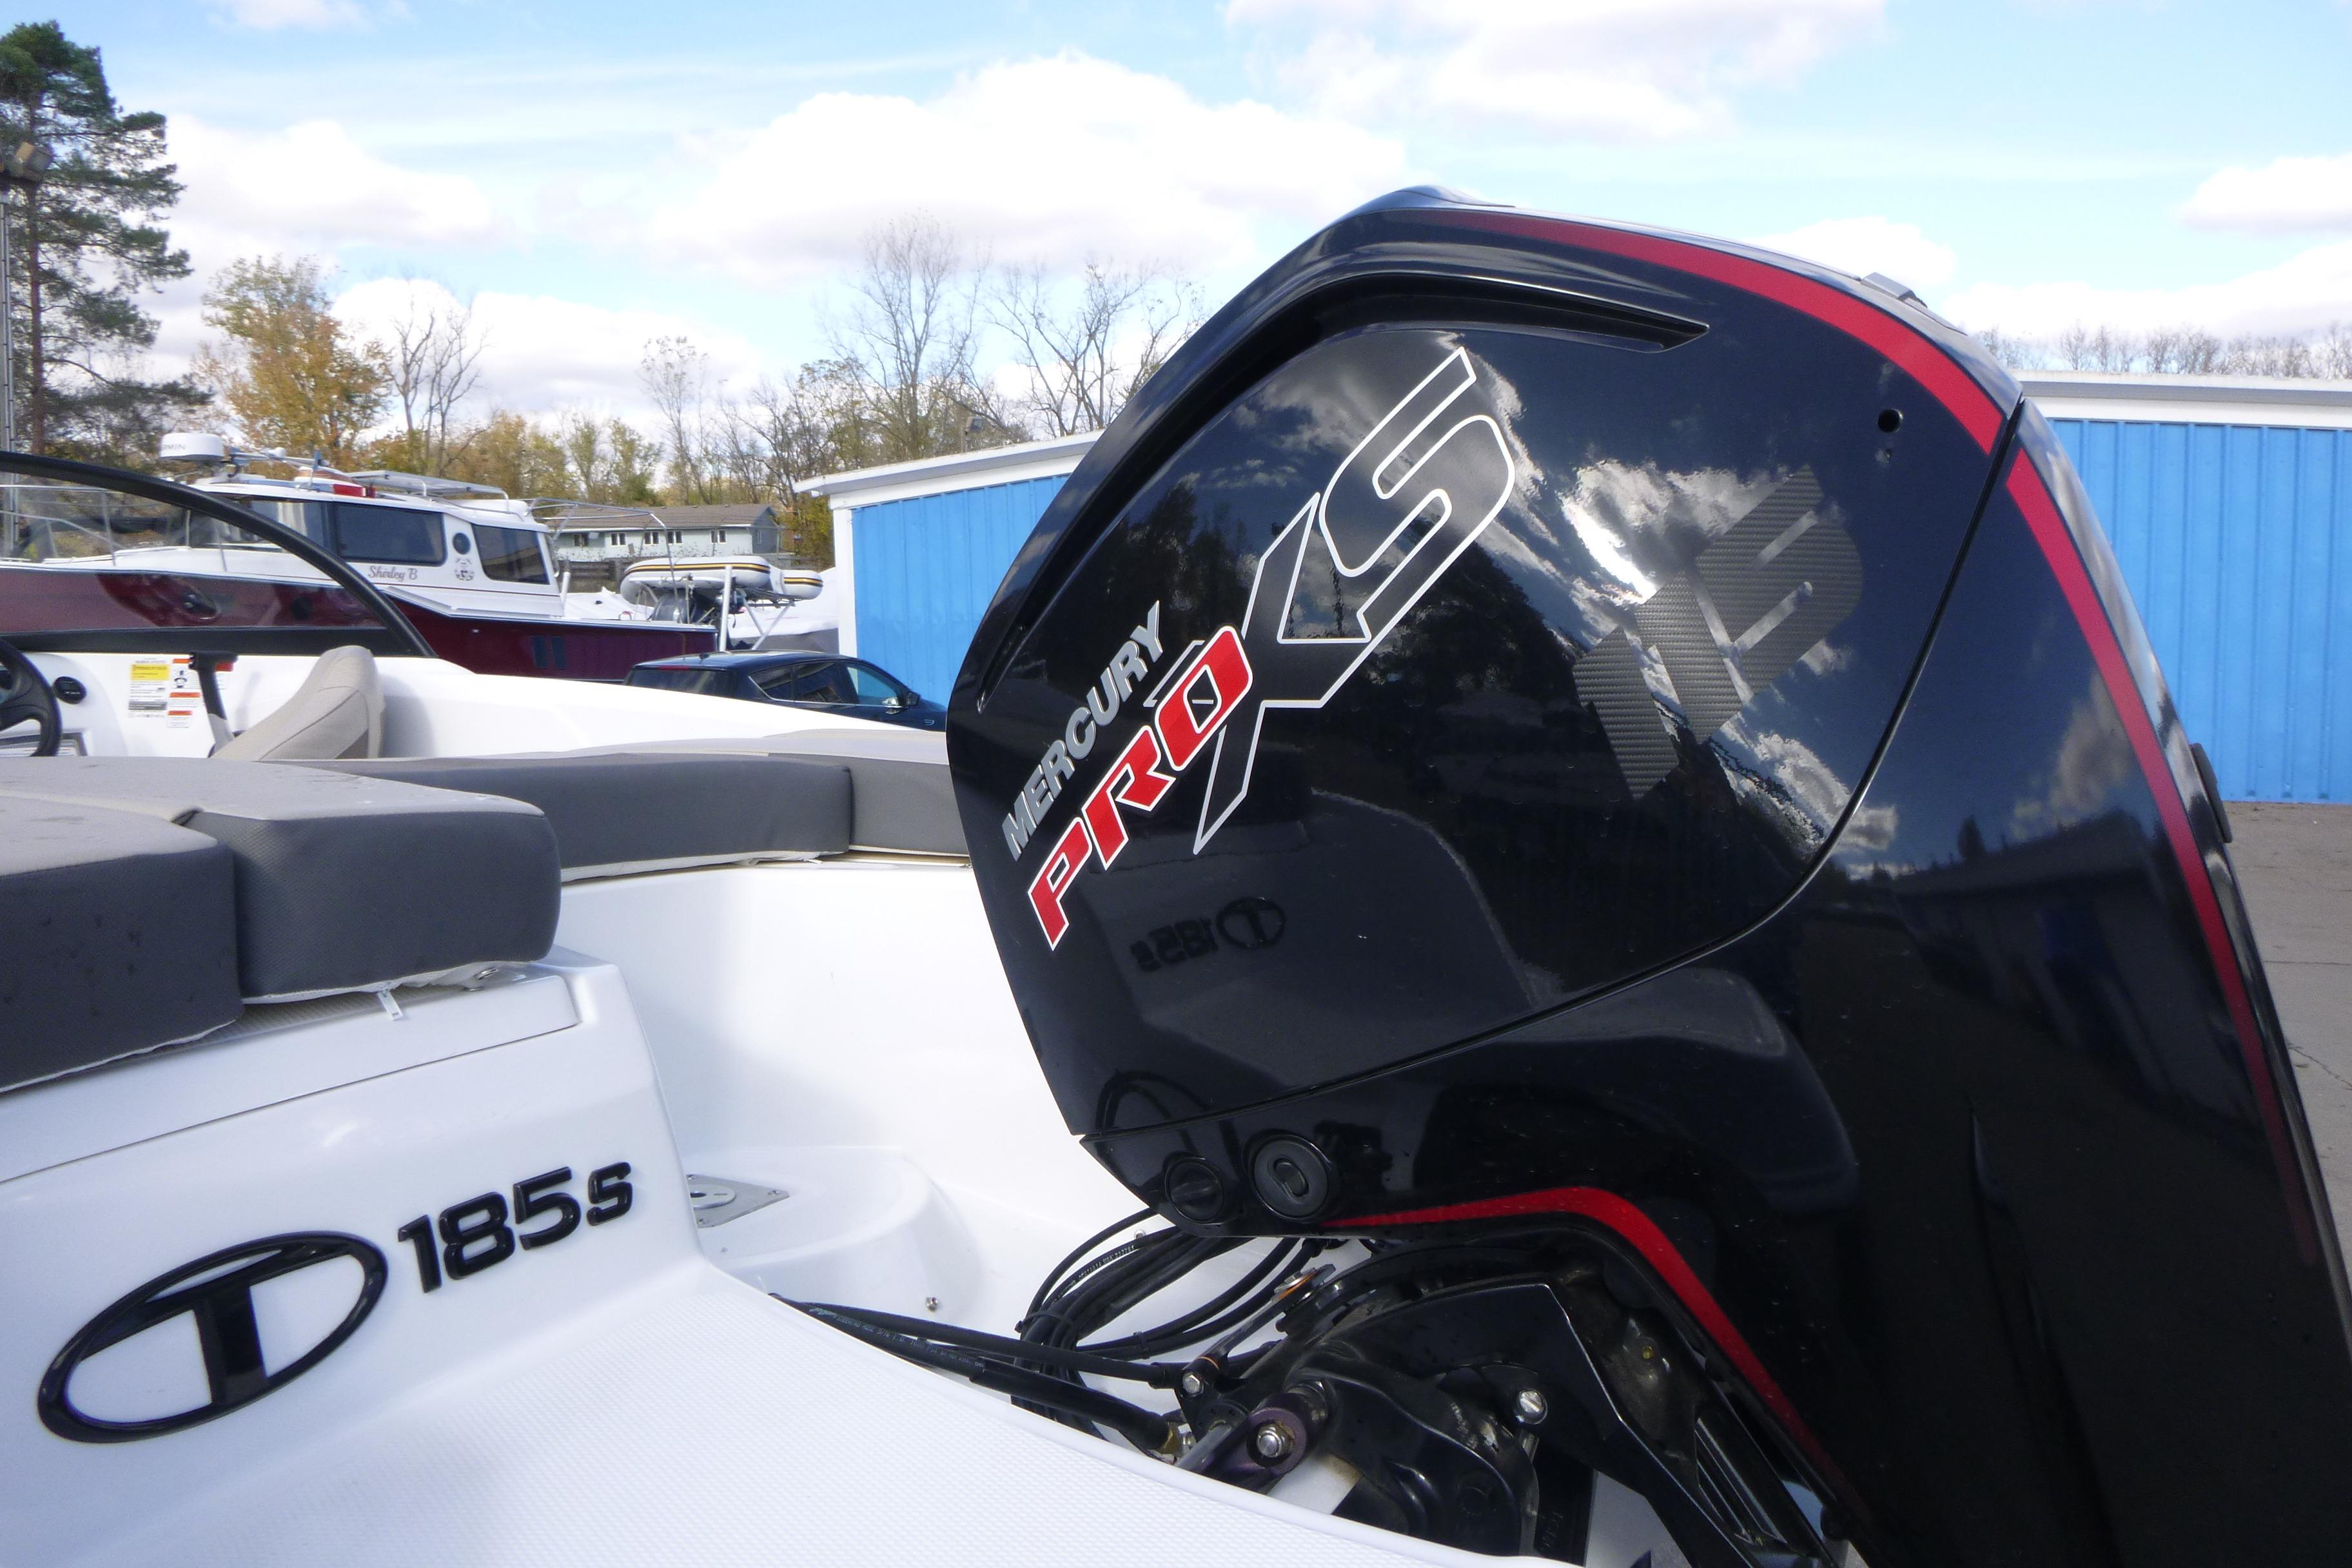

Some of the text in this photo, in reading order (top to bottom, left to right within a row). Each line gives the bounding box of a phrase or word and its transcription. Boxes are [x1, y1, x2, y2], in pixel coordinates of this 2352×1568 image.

[368, 565, 418, 582] Shirley B
[1573, 465, 1863, 799] 115
[1001, 600, 1161, 861] MERCURY
[1028, 625, 1253, 952] PRO
